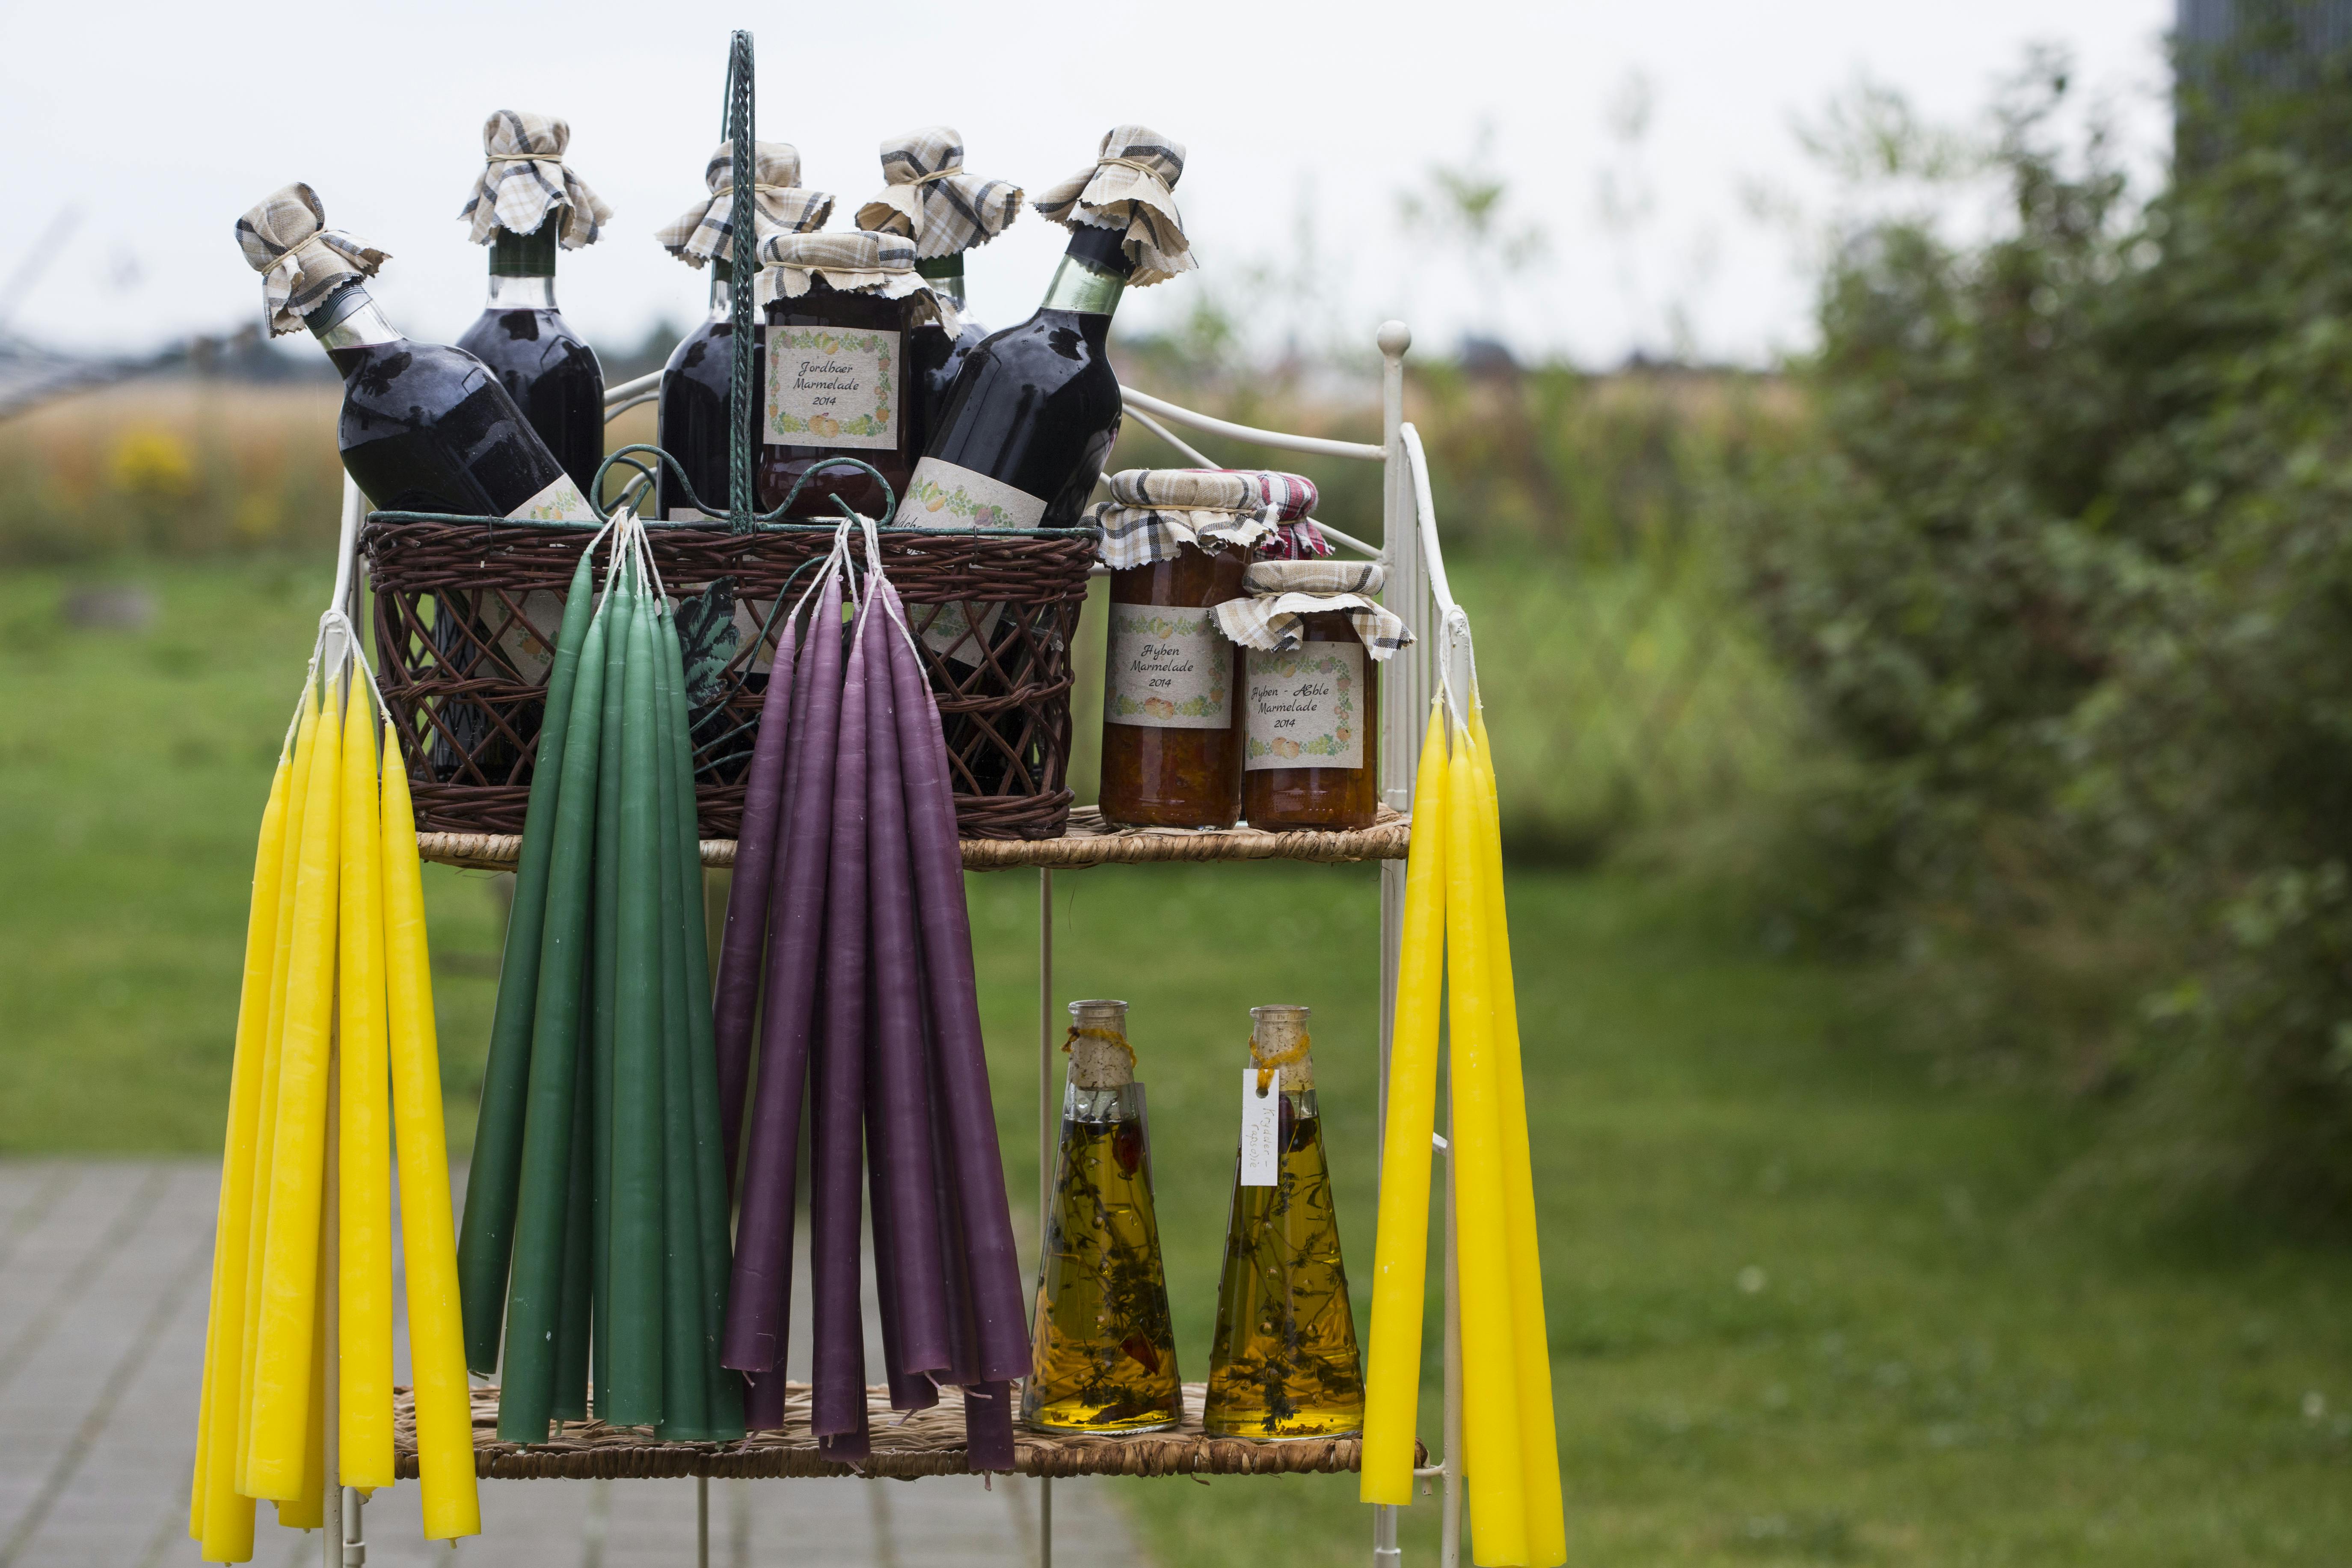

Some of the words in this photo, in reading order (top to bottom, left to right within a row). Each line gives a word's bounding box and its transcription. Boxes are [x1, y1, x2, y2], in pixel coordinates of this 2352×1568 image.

[793, 377, 859, 390] Marmelade
[813, 397, 836, 405] 2014
[1141, 644, 1180, 660] Hyben
[1130, 659, 1193, 673] Marmelade
[1149, 679, 1172, 687] 2014
[1251, 685, 1278, 702] Hyben
[1258, 699, 1317, 714] Marmelade
[1274, 719, 1296, 728] 2014
